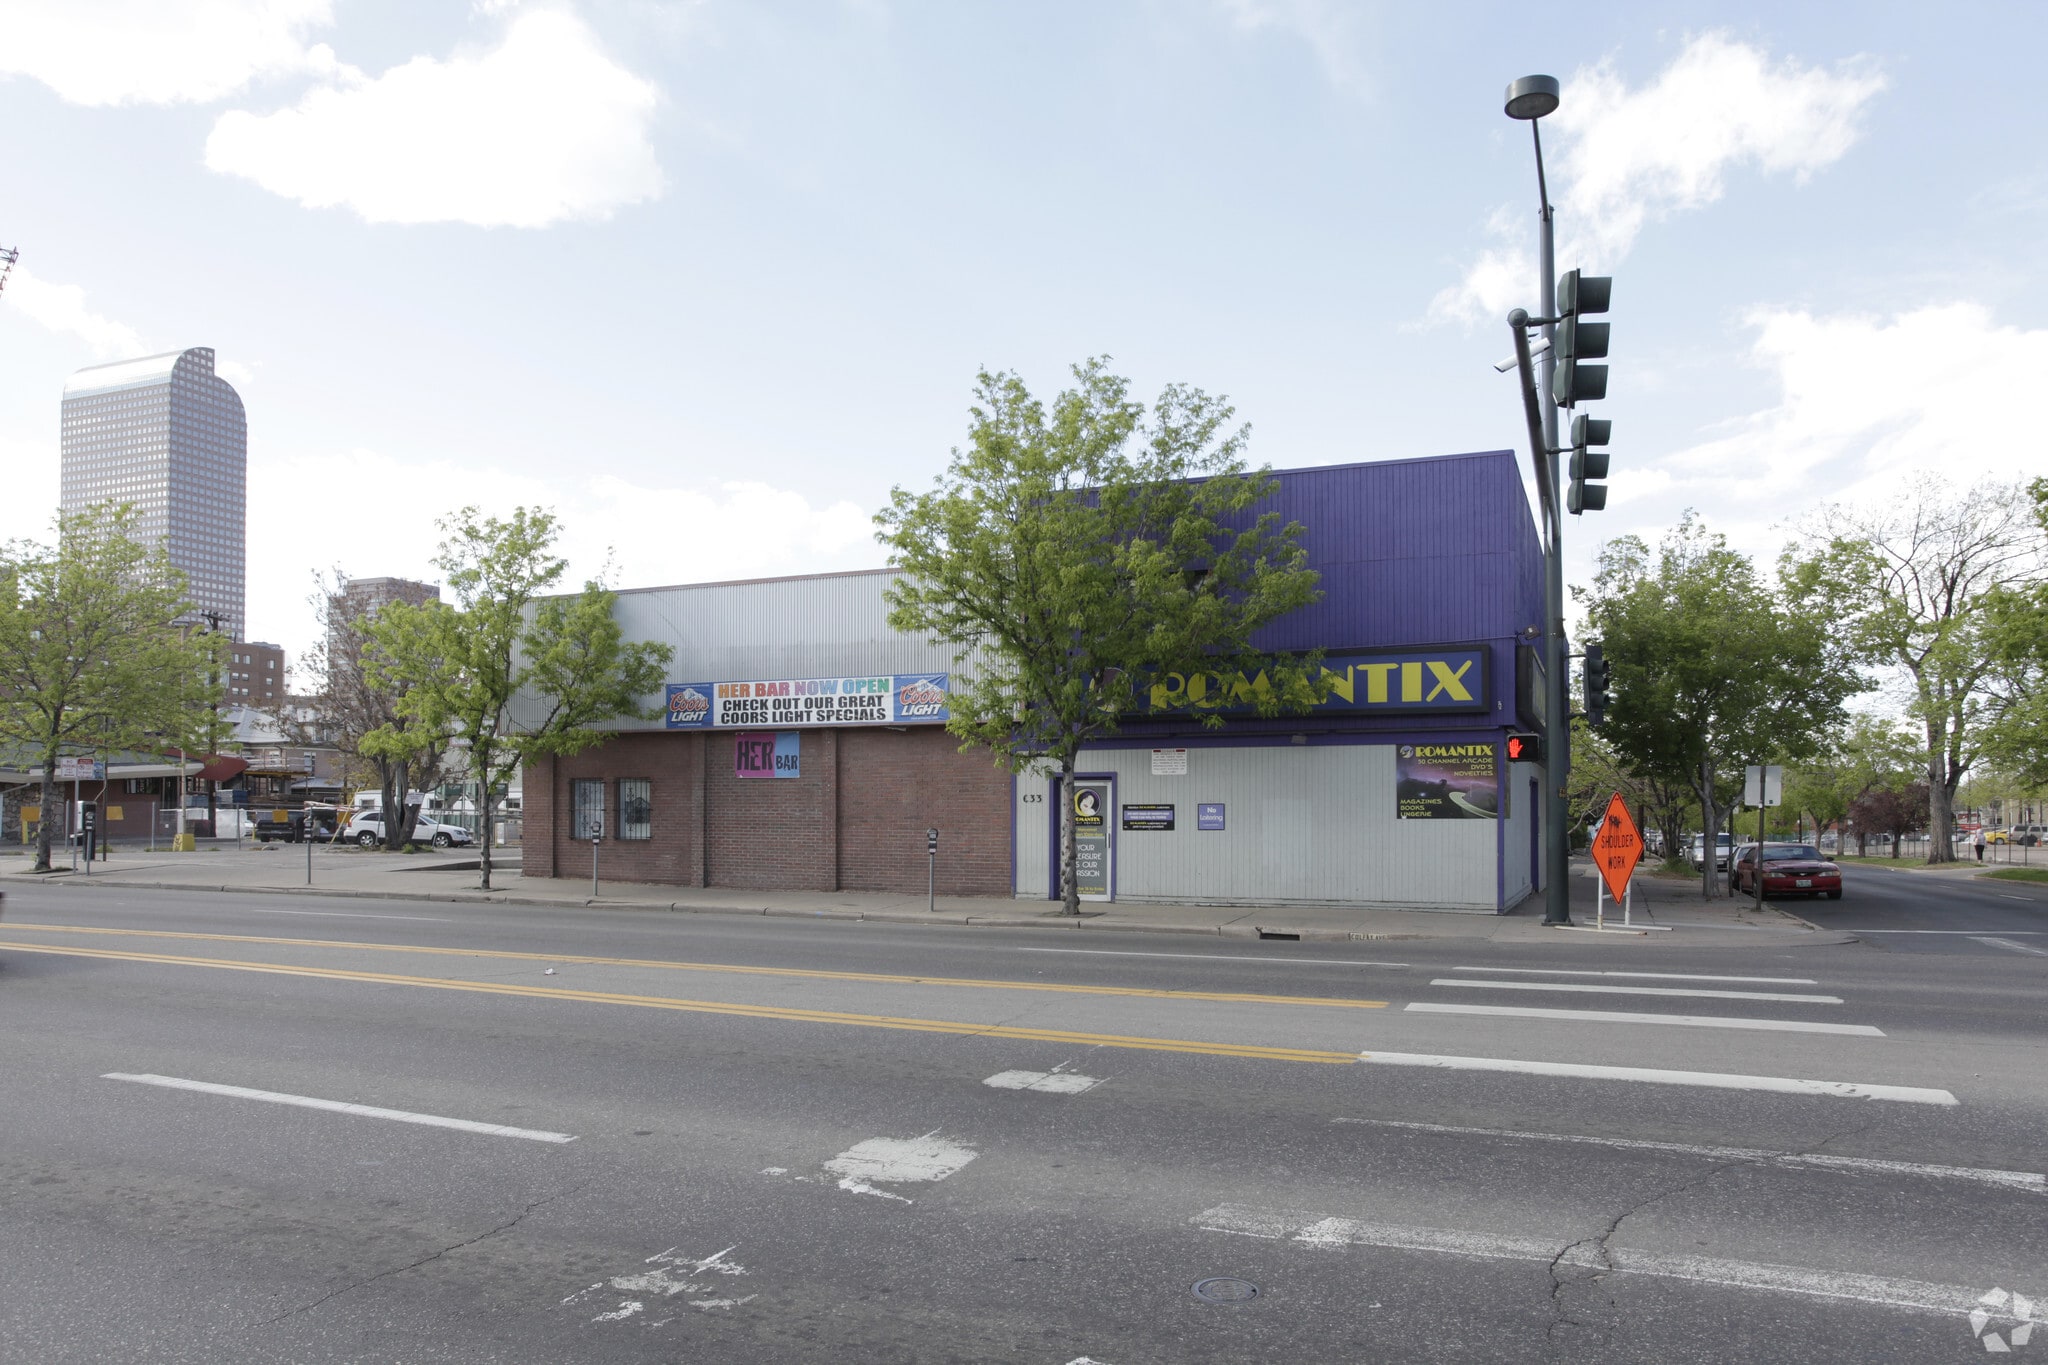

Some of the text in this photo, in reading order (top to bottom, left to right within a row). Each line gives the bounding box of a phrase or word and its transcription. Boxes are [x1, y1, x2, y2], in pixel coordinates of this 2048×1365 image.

[718, 678, 889, 698] HER BAR NOW OPEN
[900, 685, 945, 704] Coors
[670, 692, 709, 712] Coors
[723, 695, 884, 712] CHECK OUT OUR GREAT
[901, 703, 942, 716] LIGHT
[671, 711, 707, 722] LIGHT
[721, 707, 886, 724] COORS LIGHT SPECIALS
[737, 741, 773, 770] HER
[1415, 745, 1493, 757] ROMANTIX
[776, 754, 798, 770] BAR
[1601, 834, 1634, 849] SHOULDER
[1608, 856, 1625, 869] WORK
